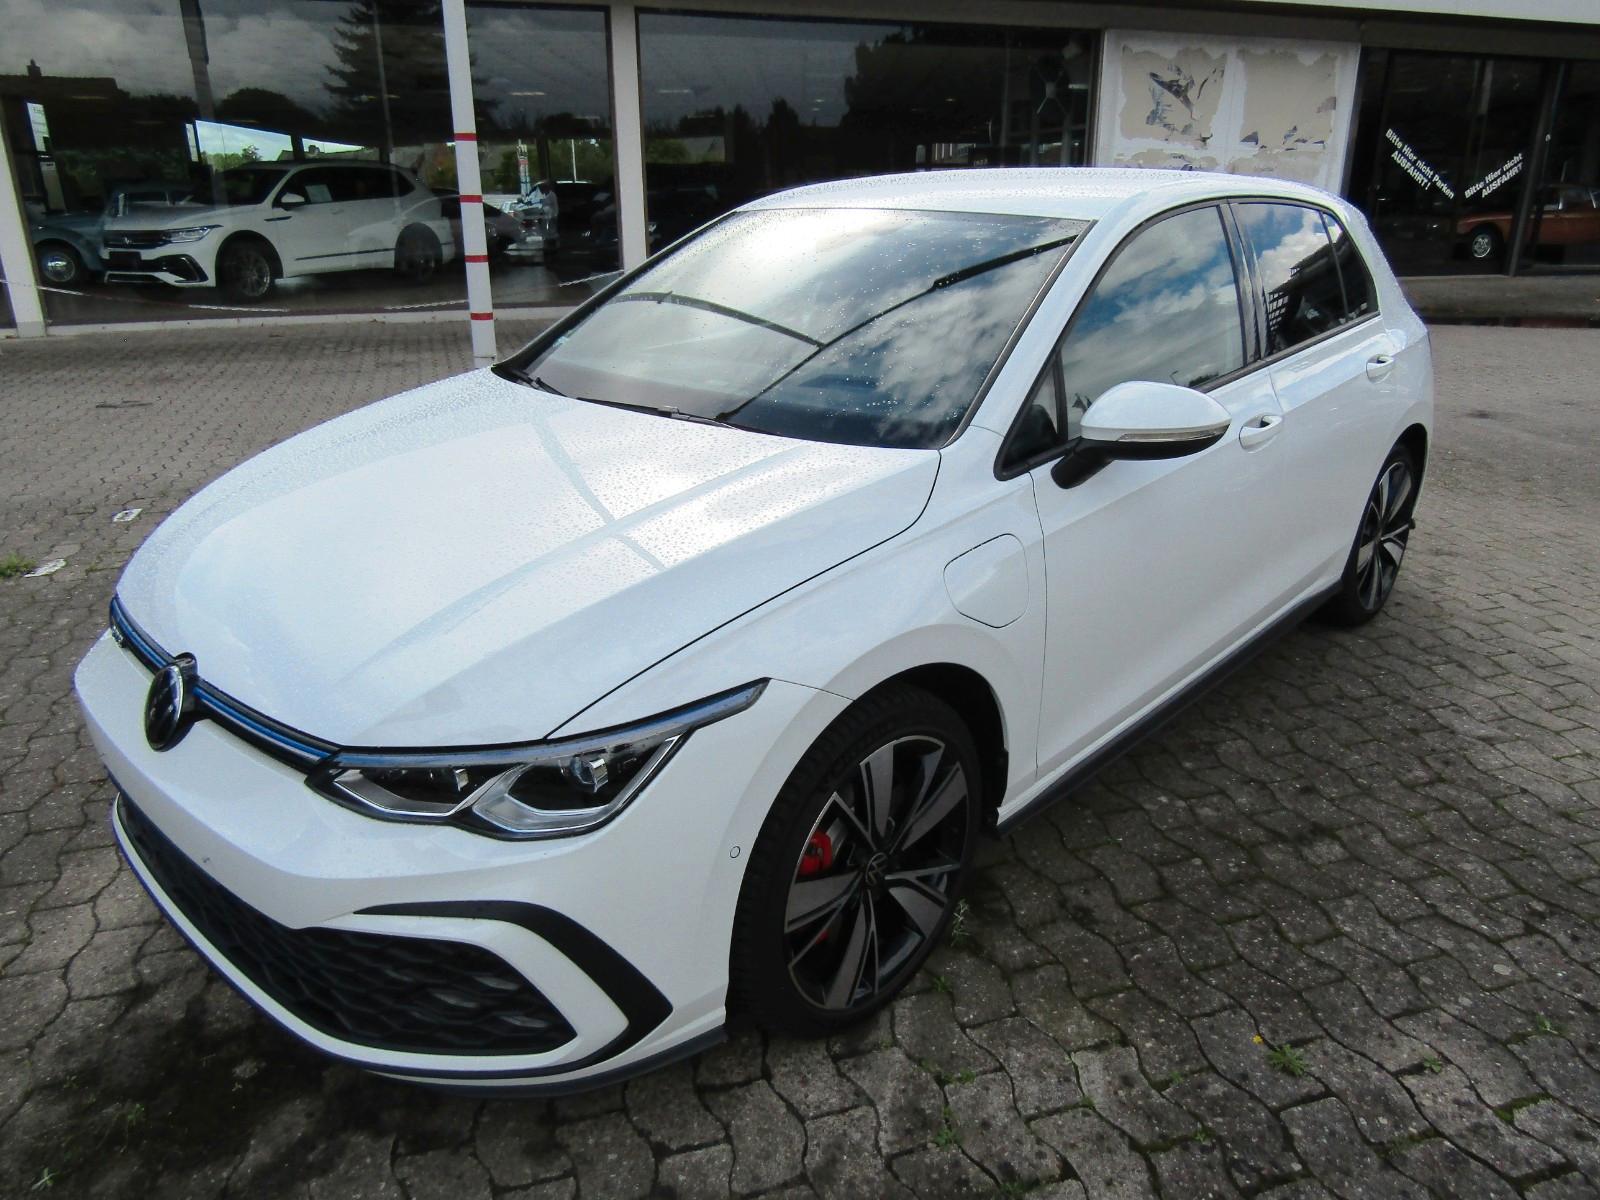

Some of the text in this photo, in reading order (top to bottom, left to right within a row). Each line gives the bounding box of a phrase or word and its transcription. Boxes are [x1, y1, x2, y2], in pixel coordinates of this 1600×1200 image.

[1385, 128, 1455, 200] Bitte Hier nicht Parken
[1464, 153, 1523, 199] Bitte Hier nicht
